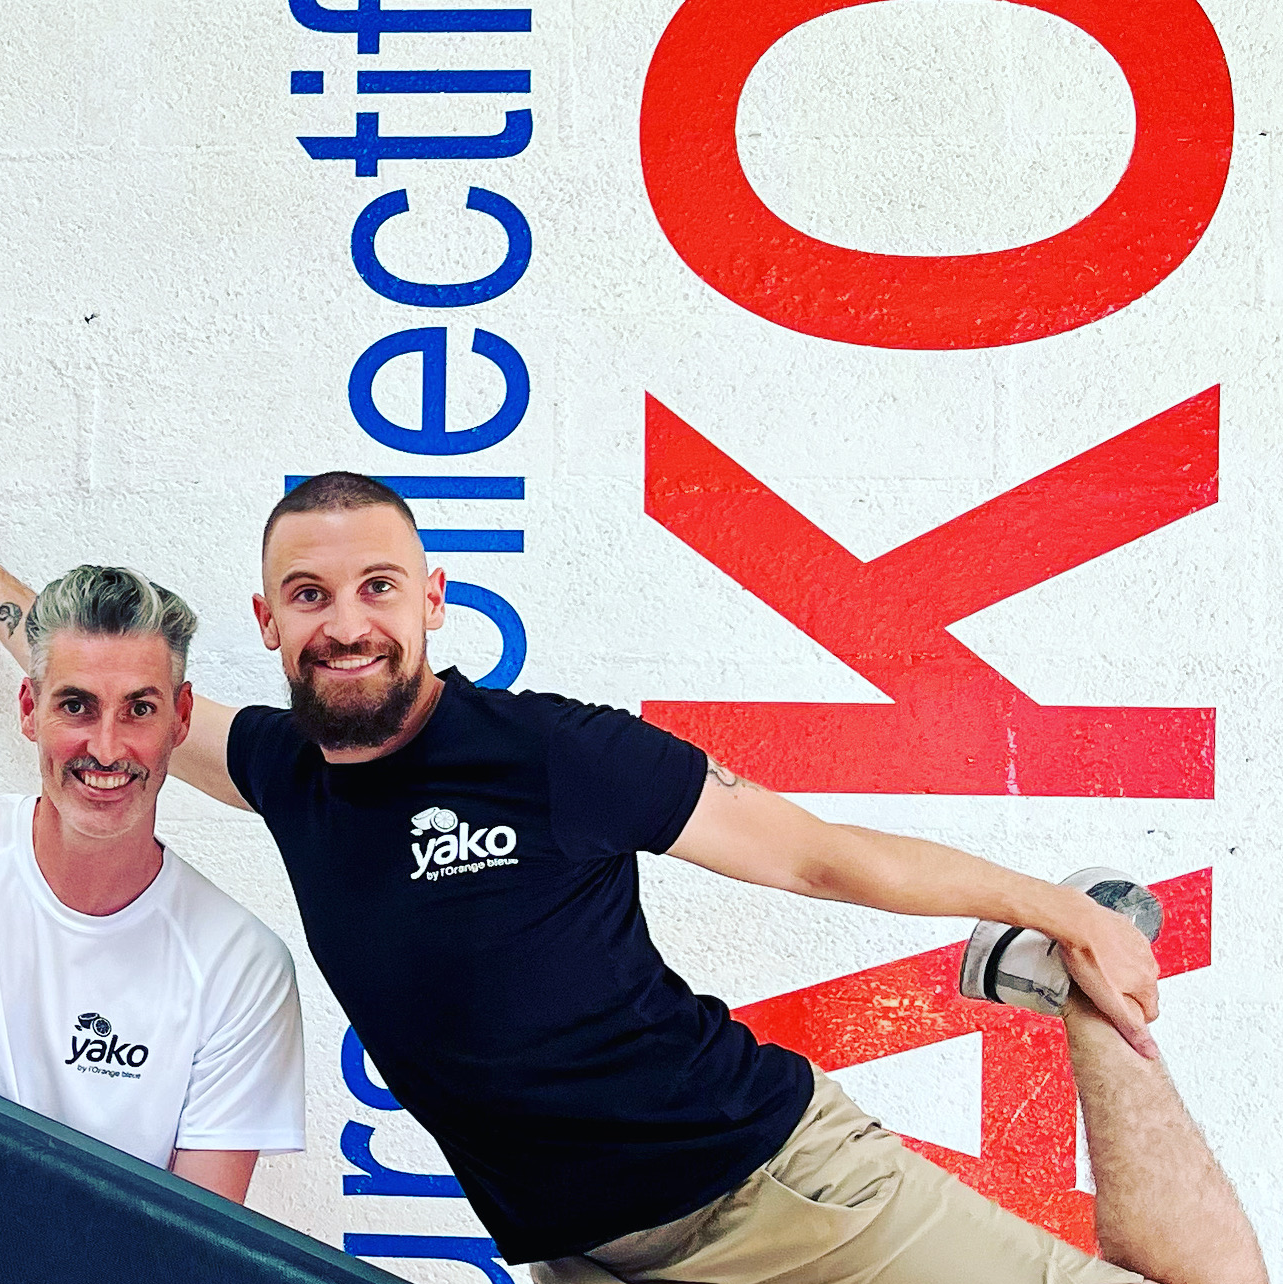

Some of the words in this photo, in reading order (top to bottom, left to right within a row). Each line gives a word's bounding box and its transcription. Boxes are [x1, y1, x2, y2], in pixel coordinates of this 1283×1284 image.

[410, 822, 516, 879] yako
[426, 871, 439, 881] by
[65, 1034, 149, 1068] yako
[77, 1065, 87, 1073] by
